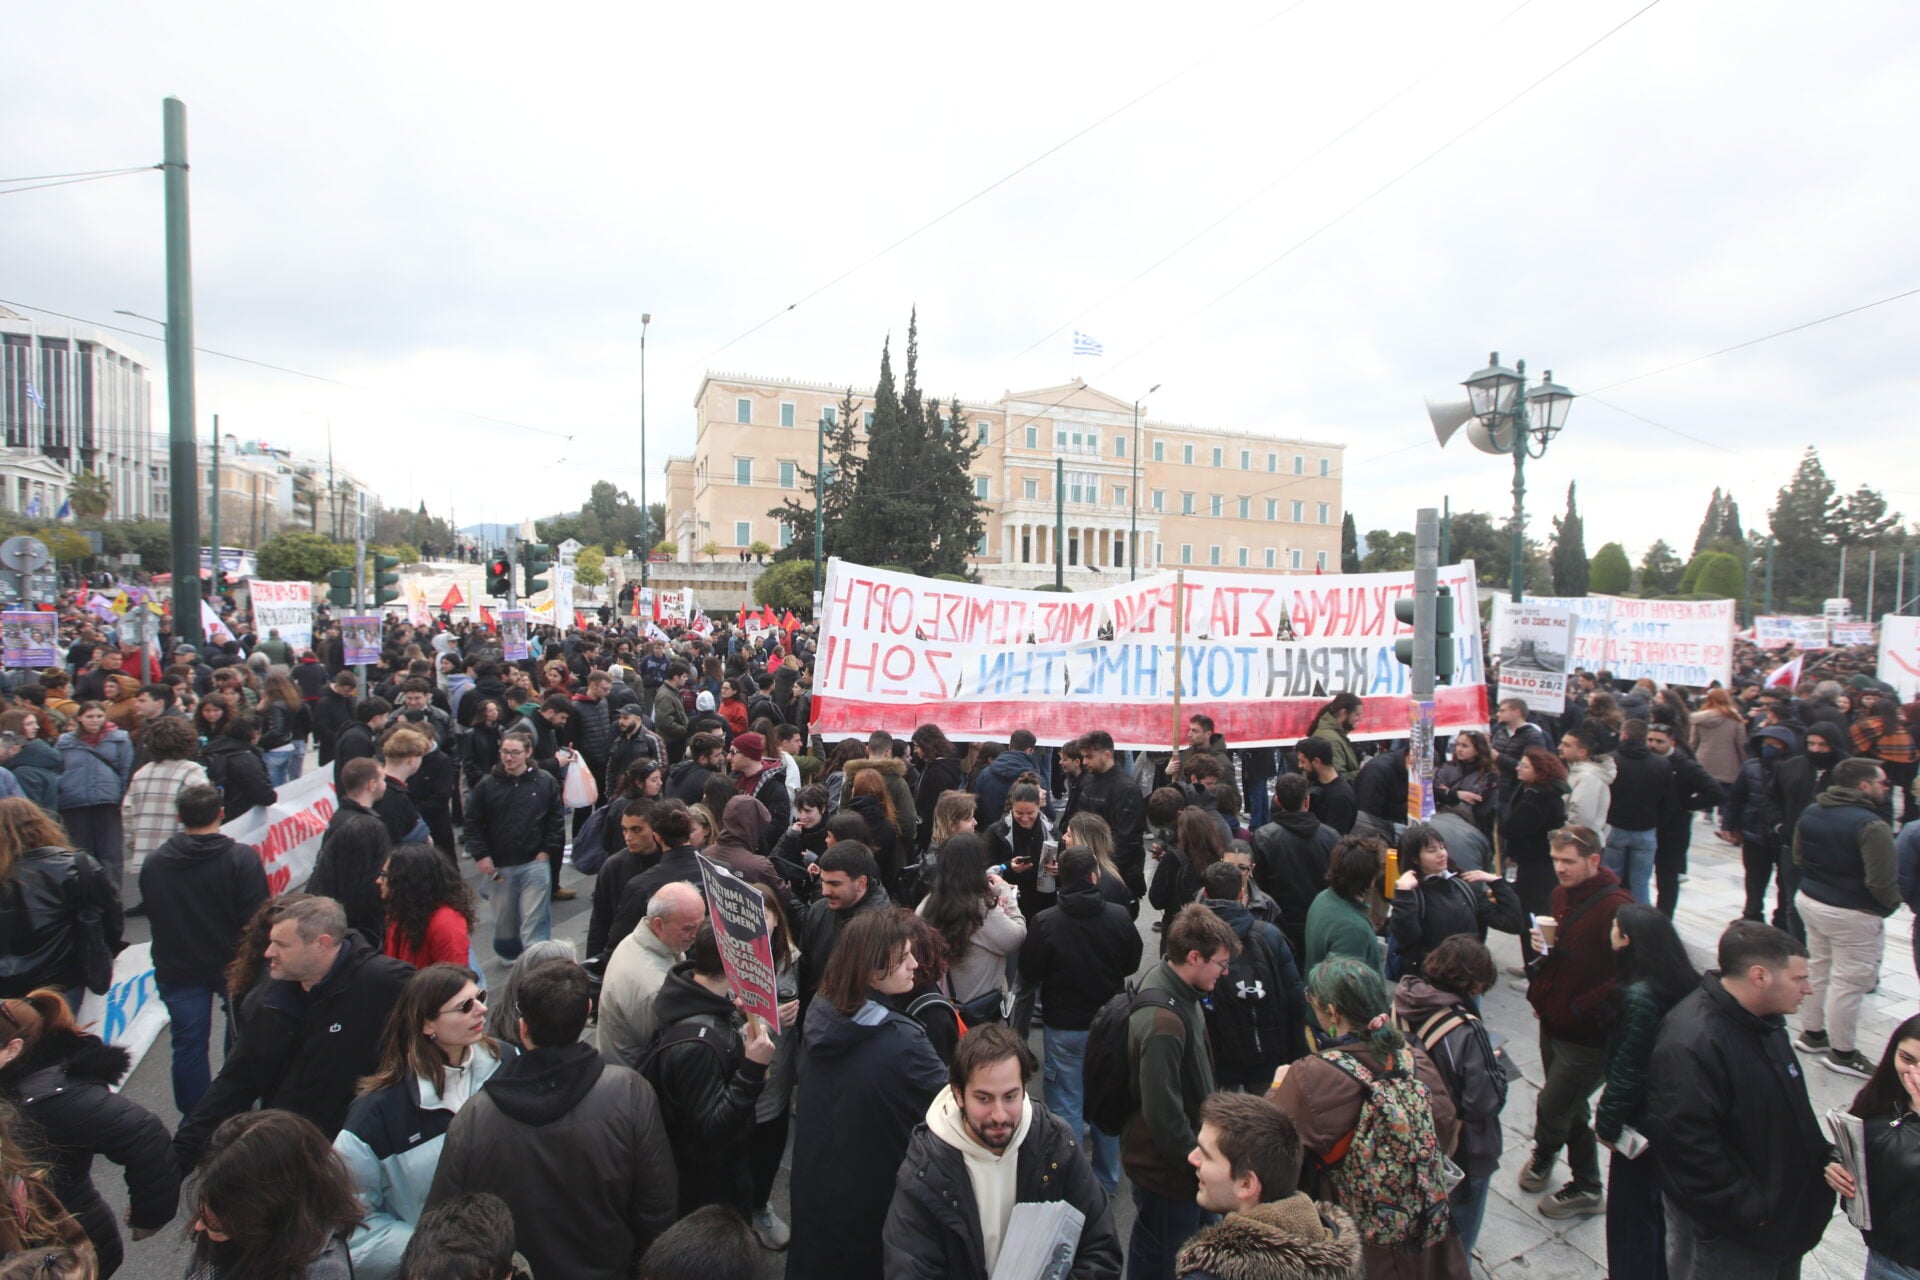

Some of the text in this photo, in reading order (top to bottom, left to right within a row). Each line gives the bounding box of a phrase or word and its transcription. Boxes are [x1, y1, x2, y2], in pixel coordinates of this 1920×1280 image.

[1539, 680, 1562, 690] 28/2
[724, 900, 739, 913] ΜΕ
[741, 906, 762, 927] ΑΙΜΑ
